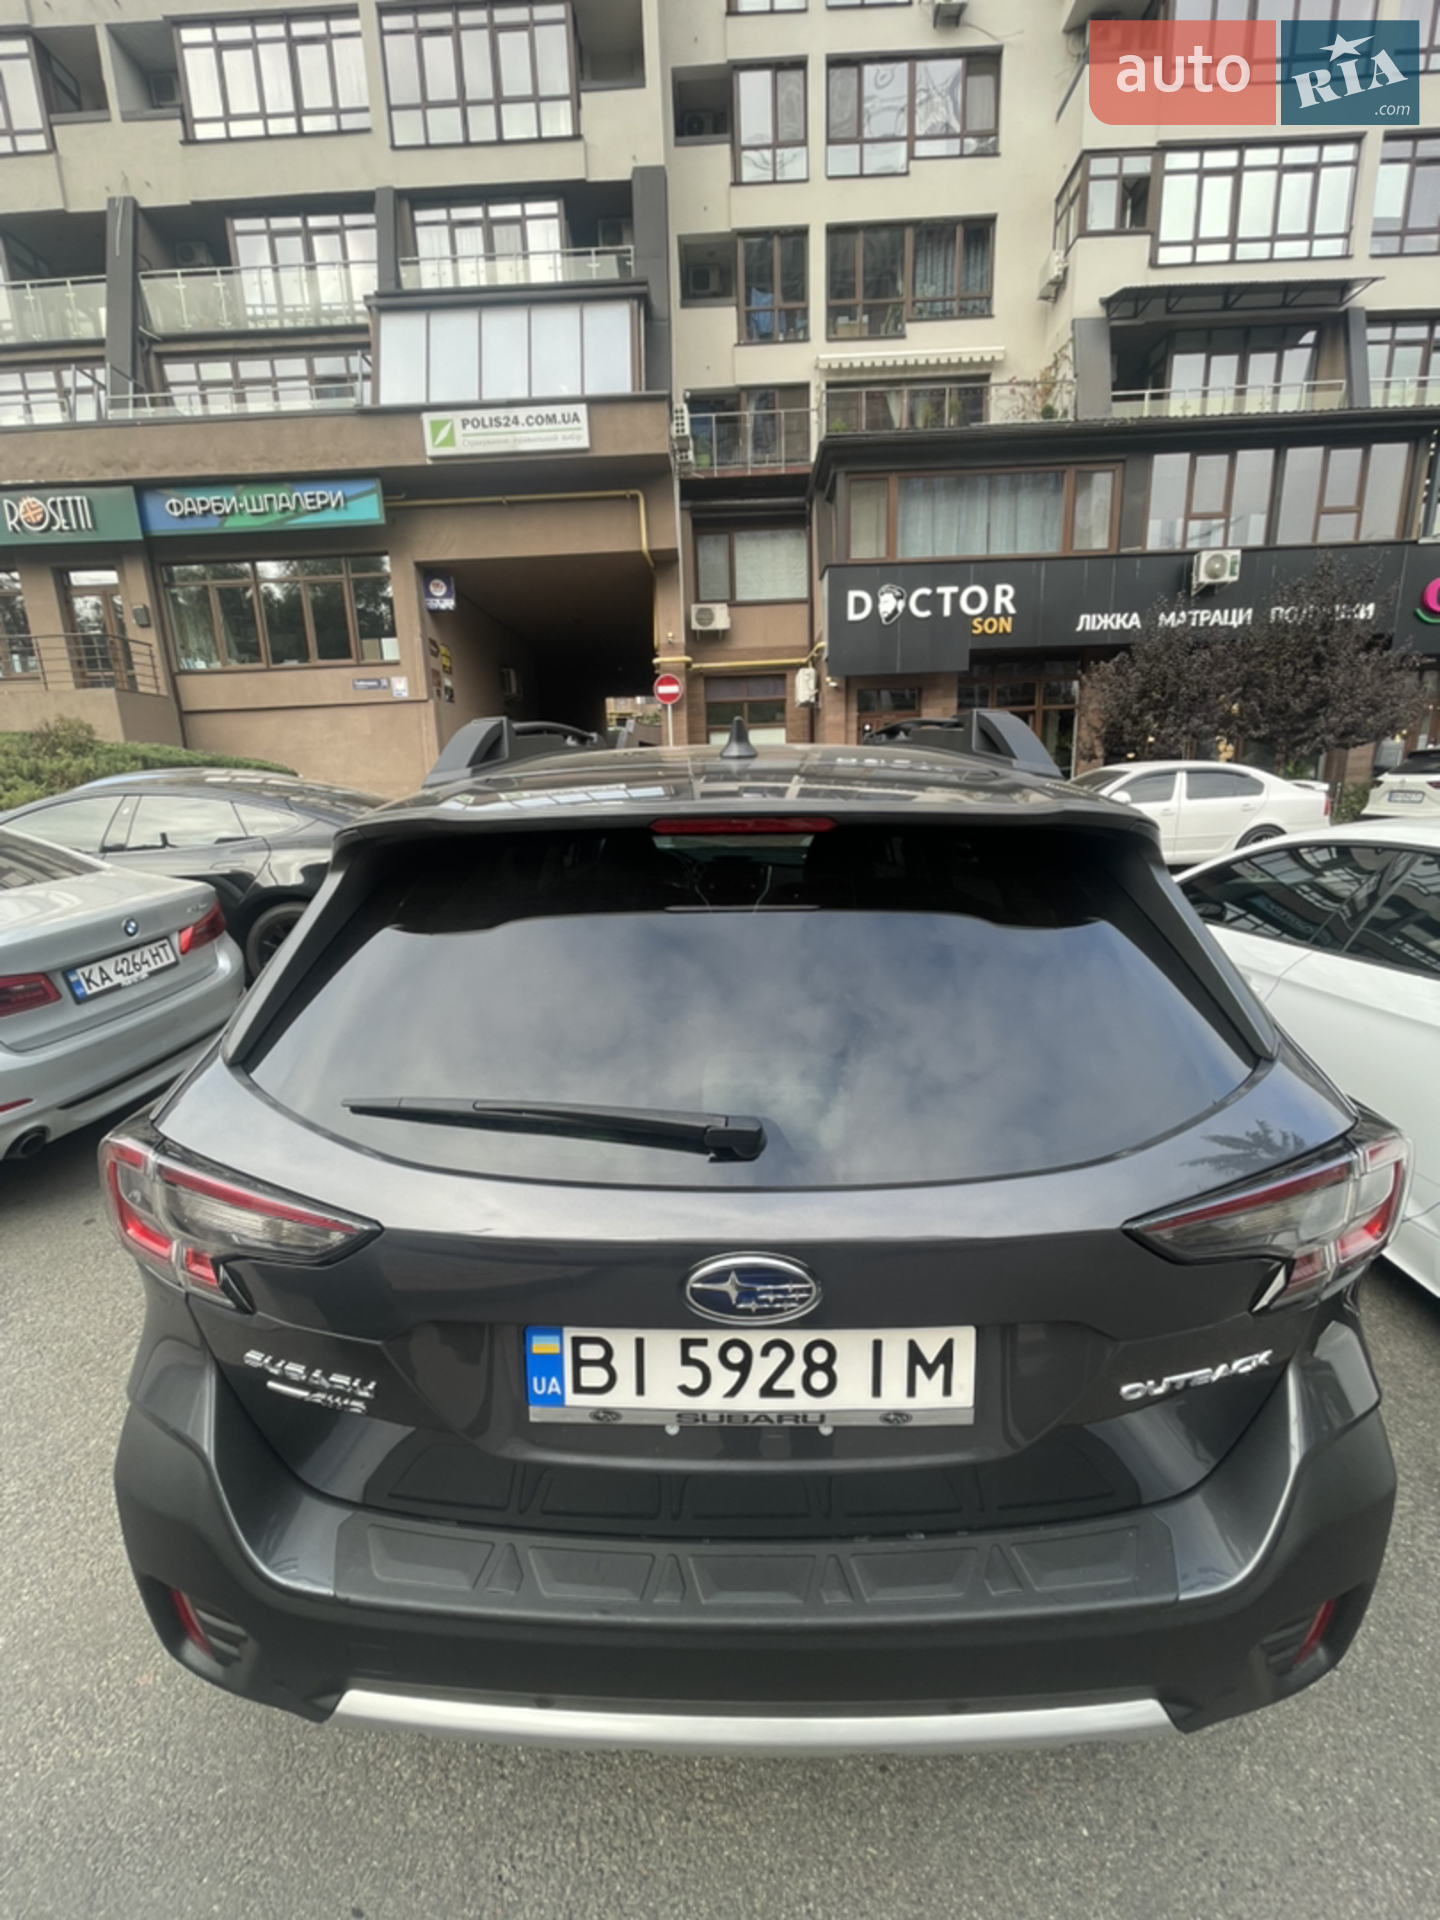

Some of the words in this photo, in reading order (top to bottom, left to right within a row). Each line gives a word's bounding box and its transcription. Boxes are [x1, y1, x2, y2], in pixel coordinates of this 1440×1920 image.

[461, 412, 581, 430] POLIS24.COM.UA
[3, 495, 94, 533] ROSETTI
[971, 616, 1013, 635] SON
[1076, 612, 1141, 632] ЛІЖКА
[81, 966, 114, 991] KA
[113, 950, 152, 977] 4264
[148, 943, 171, 966] HT
[533, 1377, 561, 1395] UA
[571, 1336, 645, 1396] BI
[677, 1337, 837, 1398] 5928
[872, 1337, 955, 1398] IM
[675, 1413, 826, 1425] SUBARU
